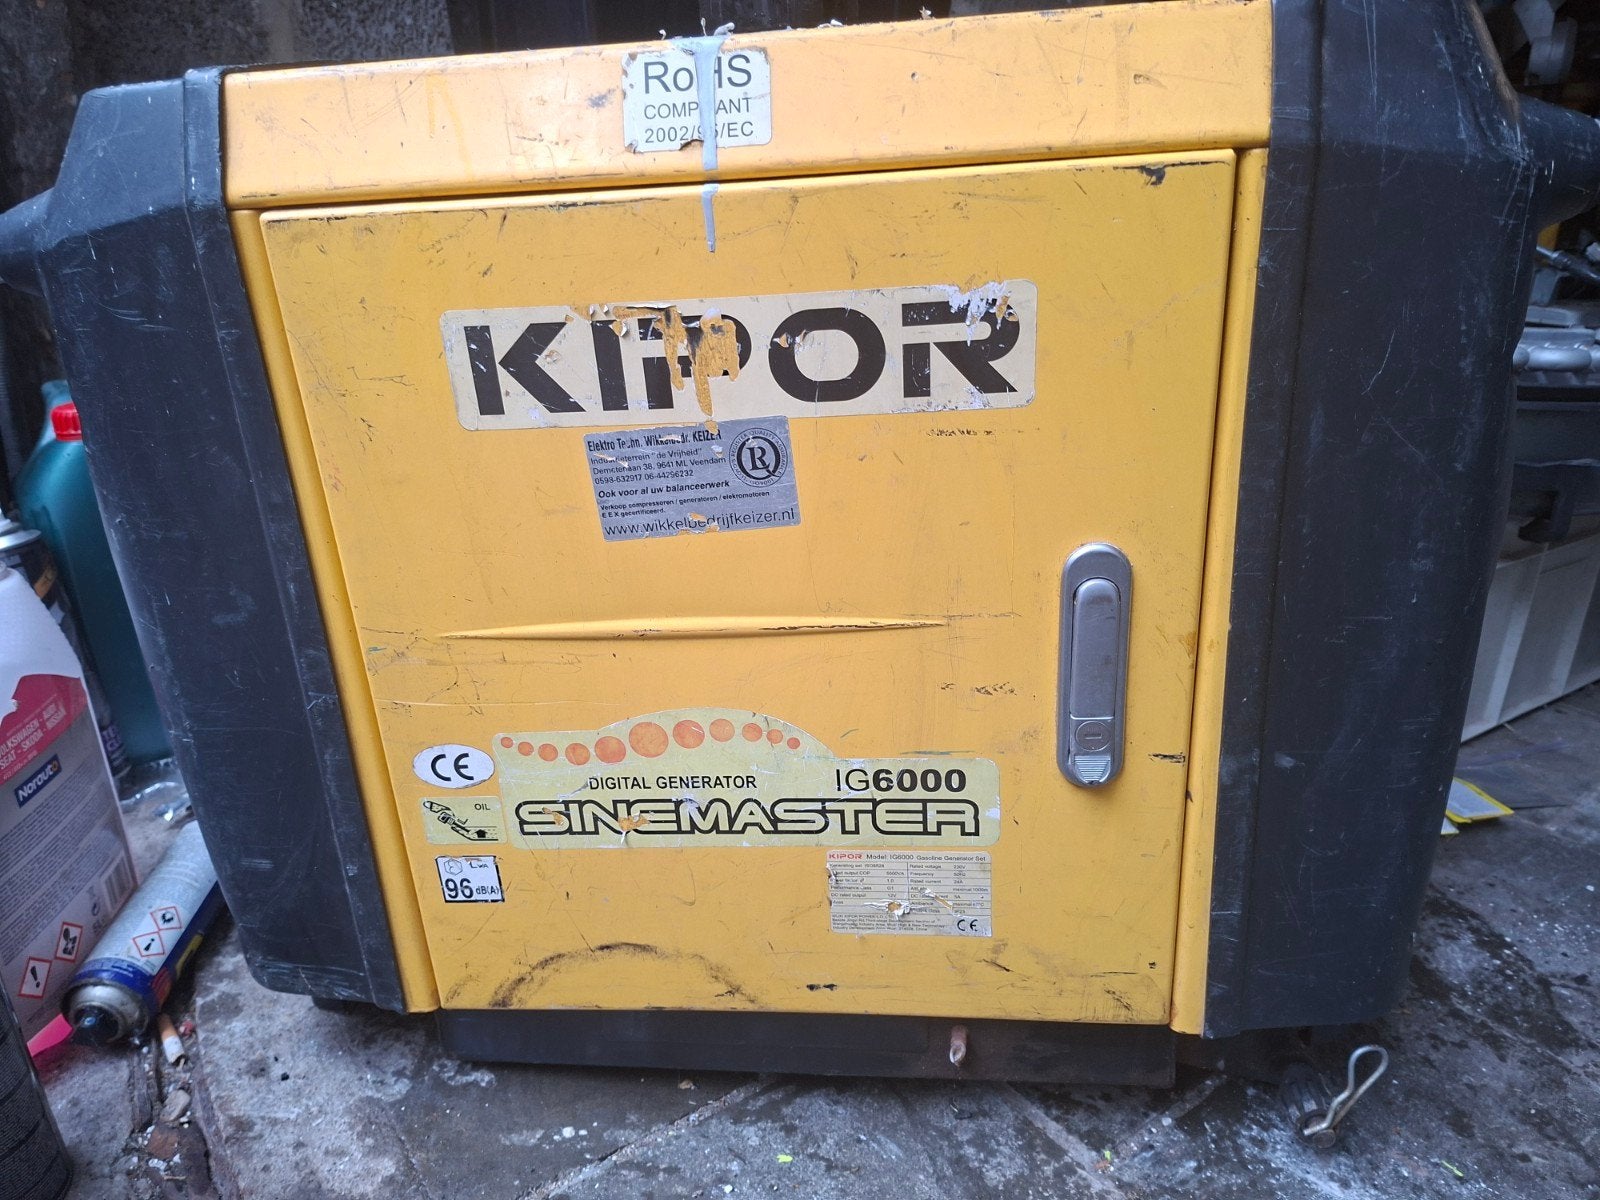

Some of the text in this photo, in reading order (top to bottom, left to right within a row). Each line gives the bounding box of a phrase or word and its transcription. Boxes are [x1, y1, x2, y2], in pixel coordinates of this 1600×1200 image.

[644, 97, 752, 120] COMPANT
[463, 299, 1020, 416] KIPOR
[587, 439, 616, 452] Elektro
[676, 460, 688, 468] ML
[689, 457, 727, 466] Veendam
[598, 480, 730, 498] Ook voor al uw balanceerwerk
[600, 503, 627, 511] Verkoop
[628, 500, 674, 509] compressoren
[678, 495, 718, 505] generatoren
[0, 750, 17, 770] SEAT
[430, 752, 475, 782] CE
[17, 759, 59, 802] Norauto
[588, 775, 758, 790] DIGITAL GENERATOR
[835, 768, 967, 793] IG6000
[474, 803, 491, 811] OIL
[514, 797, 980, 837] SINEMASTER
[444, 877, 500, 899] 96 dB(A)
